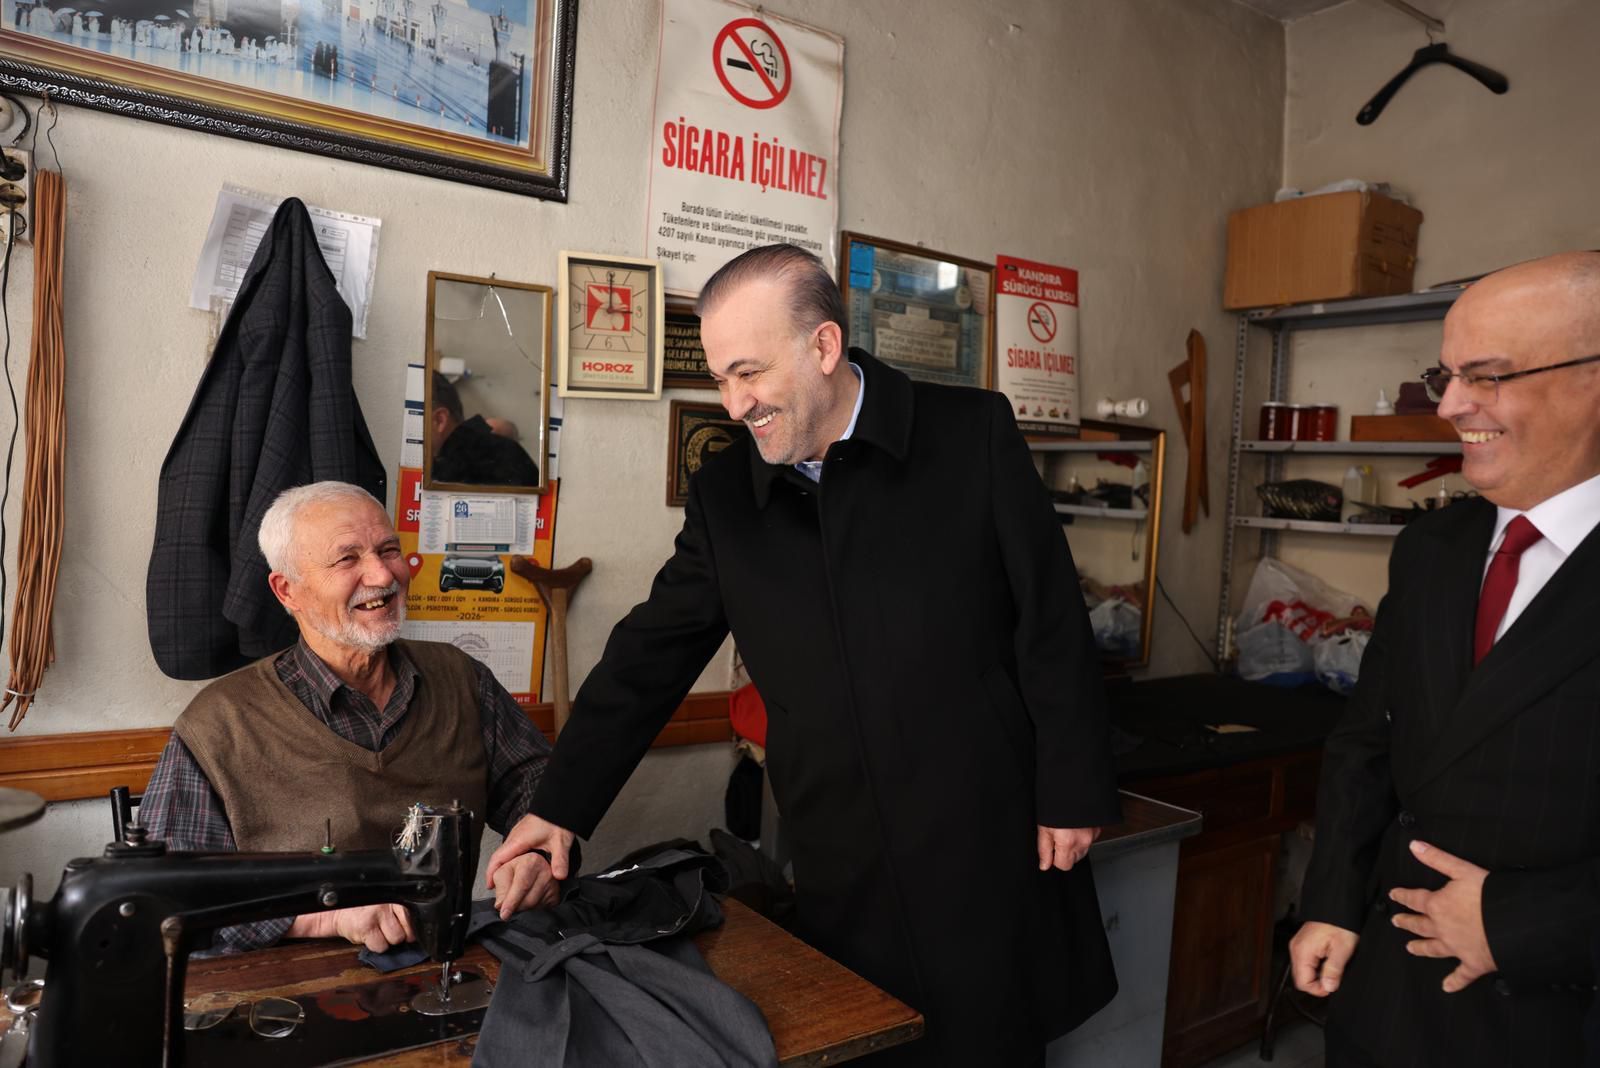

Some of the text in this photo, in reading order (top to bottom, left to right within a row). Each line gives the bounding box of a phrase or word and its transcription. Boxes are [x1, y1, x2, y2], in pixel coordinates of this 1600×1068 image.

[662, 116, 828, 200] SİGARA İÇİLMEZ
[662, 212, 700, 229] Tüketenlere
[702, 222, 710, 230] ve
[711, 222, 754, 238] tüketilmesine
[755, 229, 766, 240] göz
[767, 233, 787, 244] yuman
[681, 202, 704, 216] Burada
[706, 206, 722, 218] tütün
[724, 209, 749, 223] ürünleri
[750, 212, 783, 230] tüketilmesi
[658, 226, 675, 238] 4207
[676, 230, 694, 242] sayılı
[696, 232, 716, 245] Kanun
[718, 237, 745, 250] uyarınca
[656, 246, 696, 264] Şikayet için:
[1018, 267, 1062, 286] KANDIRA
[1002, 278, 1076, 303] SÜRÜCÜ KURSU
[582, 362, 634, 374] HOROZ
[1007, 343, 1074, 377] SİGARA İÇİLMEZ
[455, 504, 467, 512] 26
